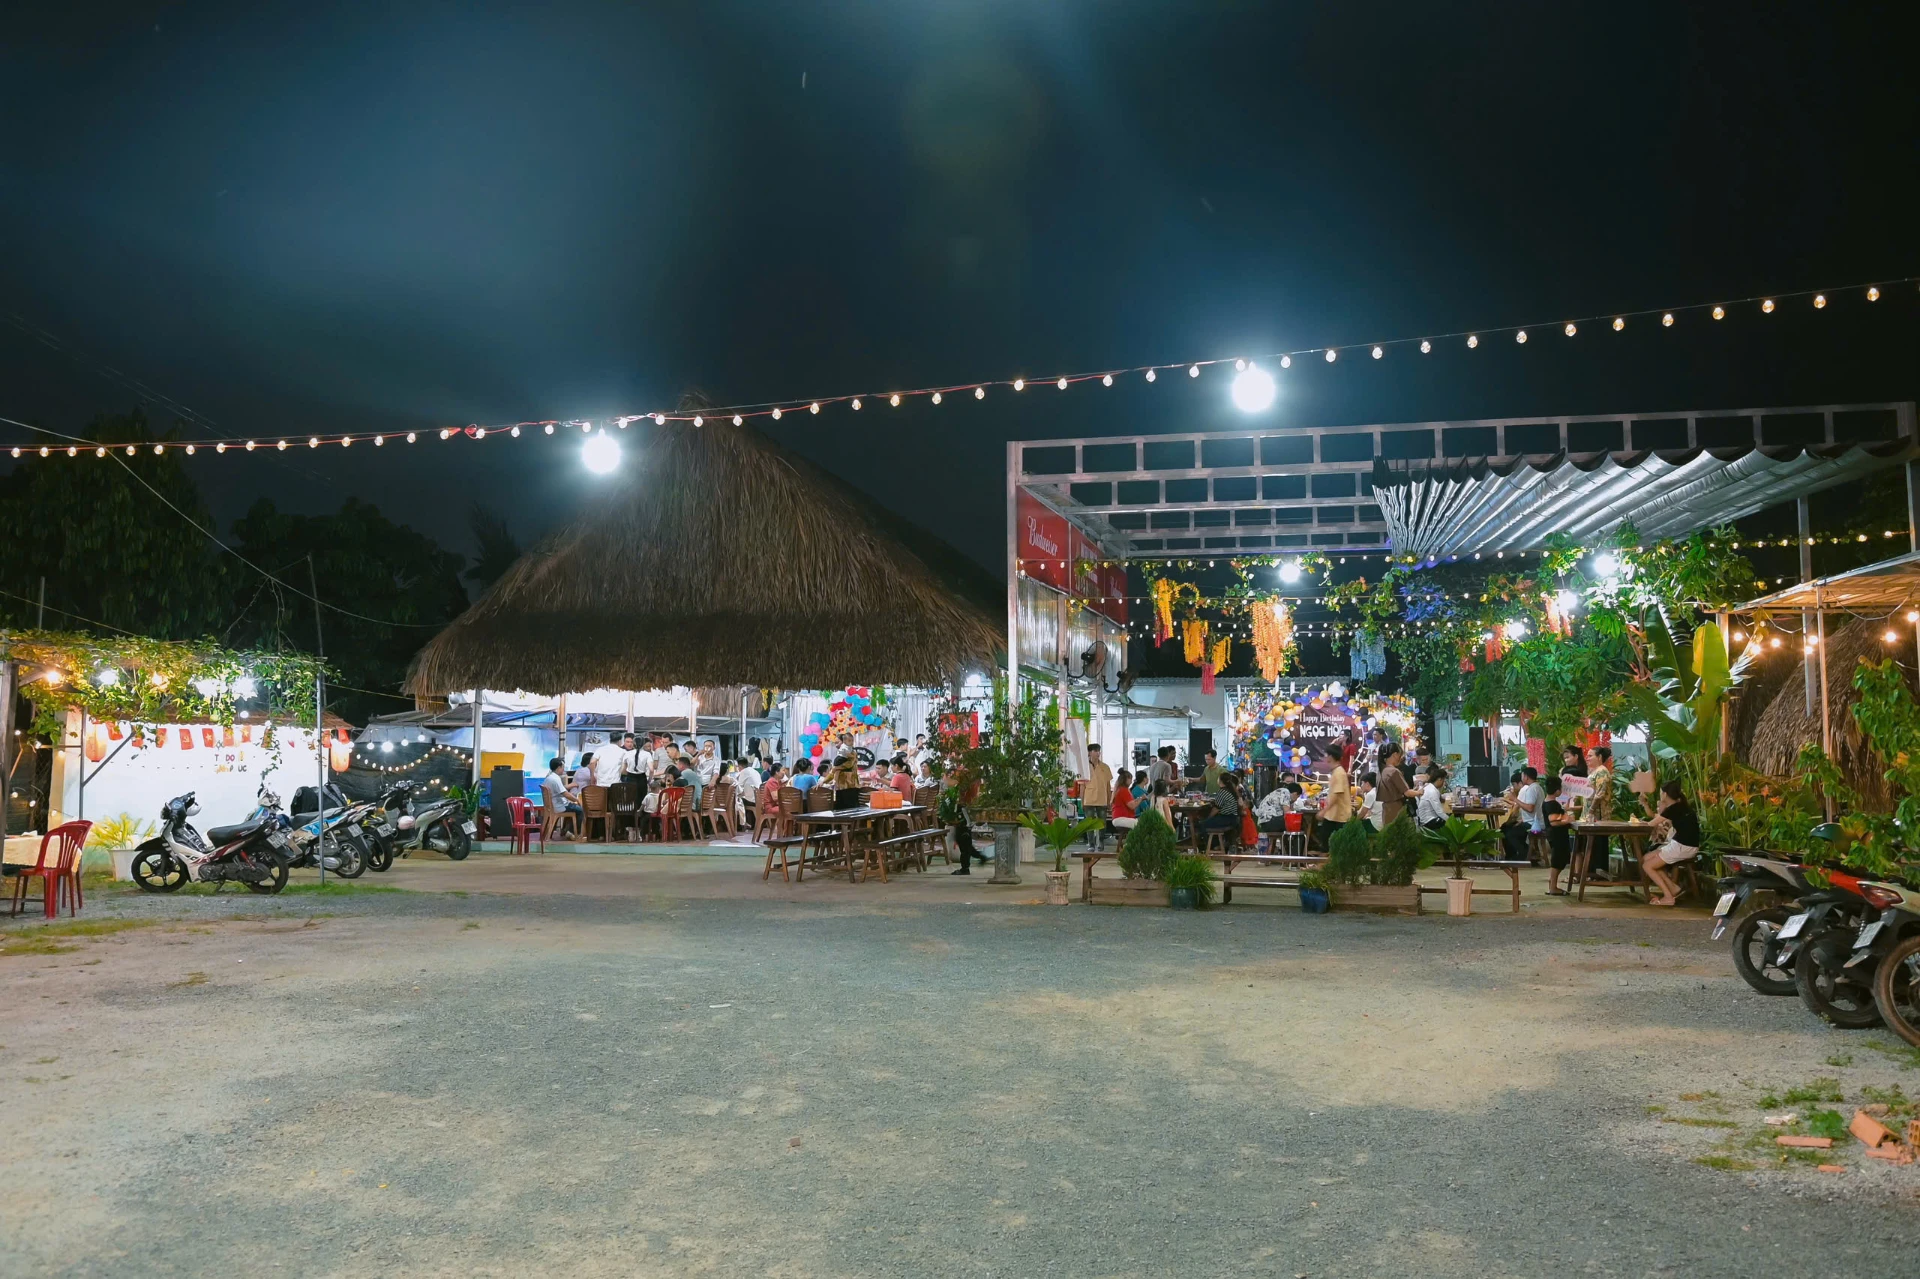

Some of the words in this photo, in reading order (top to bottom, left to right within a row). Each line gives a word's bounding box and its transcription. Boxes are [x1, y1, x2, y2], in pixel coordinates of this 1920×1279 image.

[1300, 713, 1318, 724] Happy
[1320, 712, 1345, 723] Birthday
[1300, 724, 1325, 739] NGỌC
[1565, 776, 1587, 785] Happy
